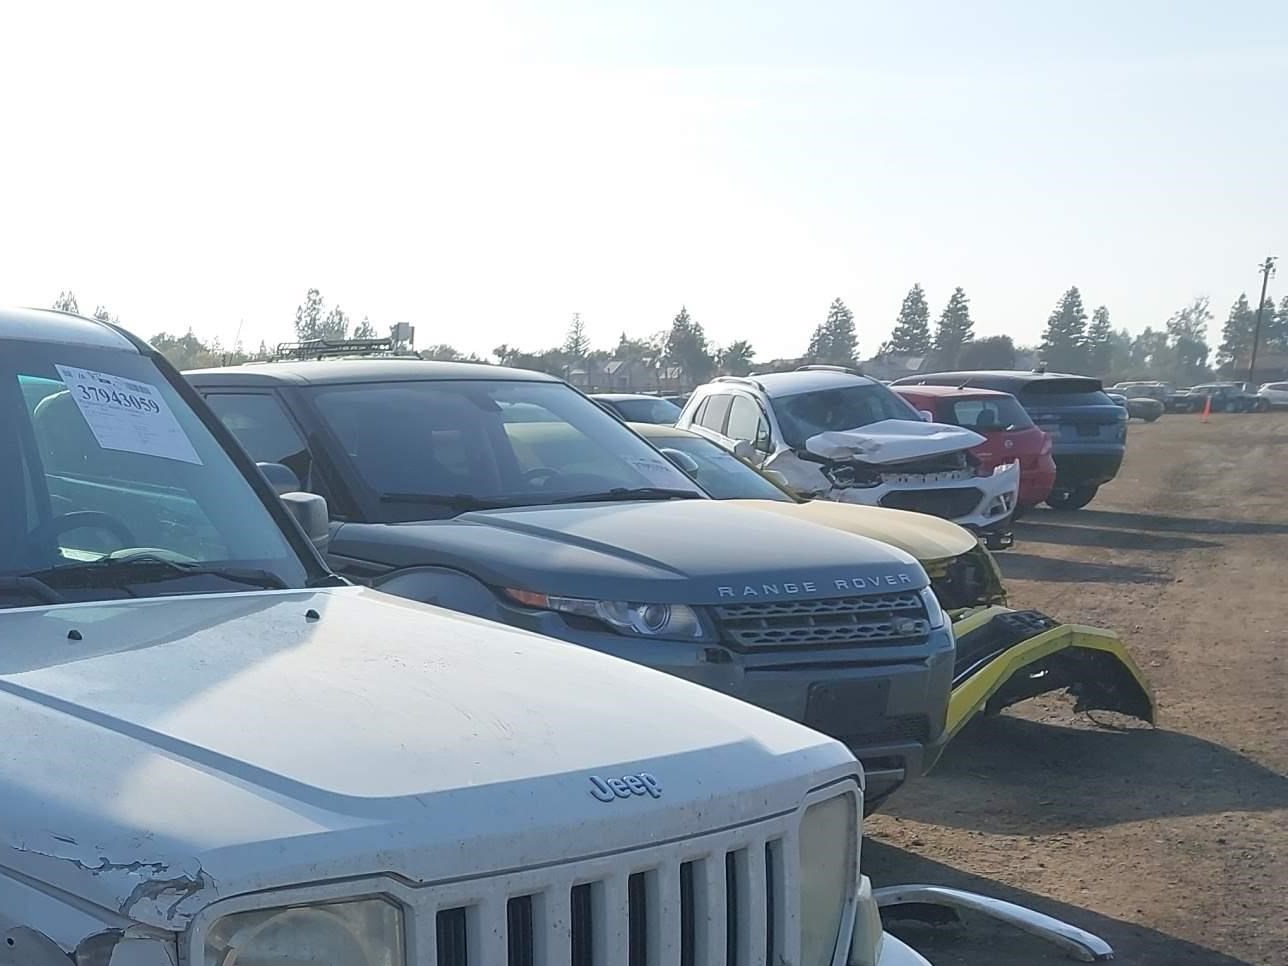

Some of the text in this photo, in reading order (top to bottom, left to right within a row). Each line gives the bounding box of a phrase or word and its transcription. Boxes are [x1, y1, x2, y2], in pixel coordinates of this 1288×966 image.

[77, 384, 160, 414] 37943059
[718, 573, 912, 597] RANGE ROVER
[589, 772, 662, 803] Jeep
